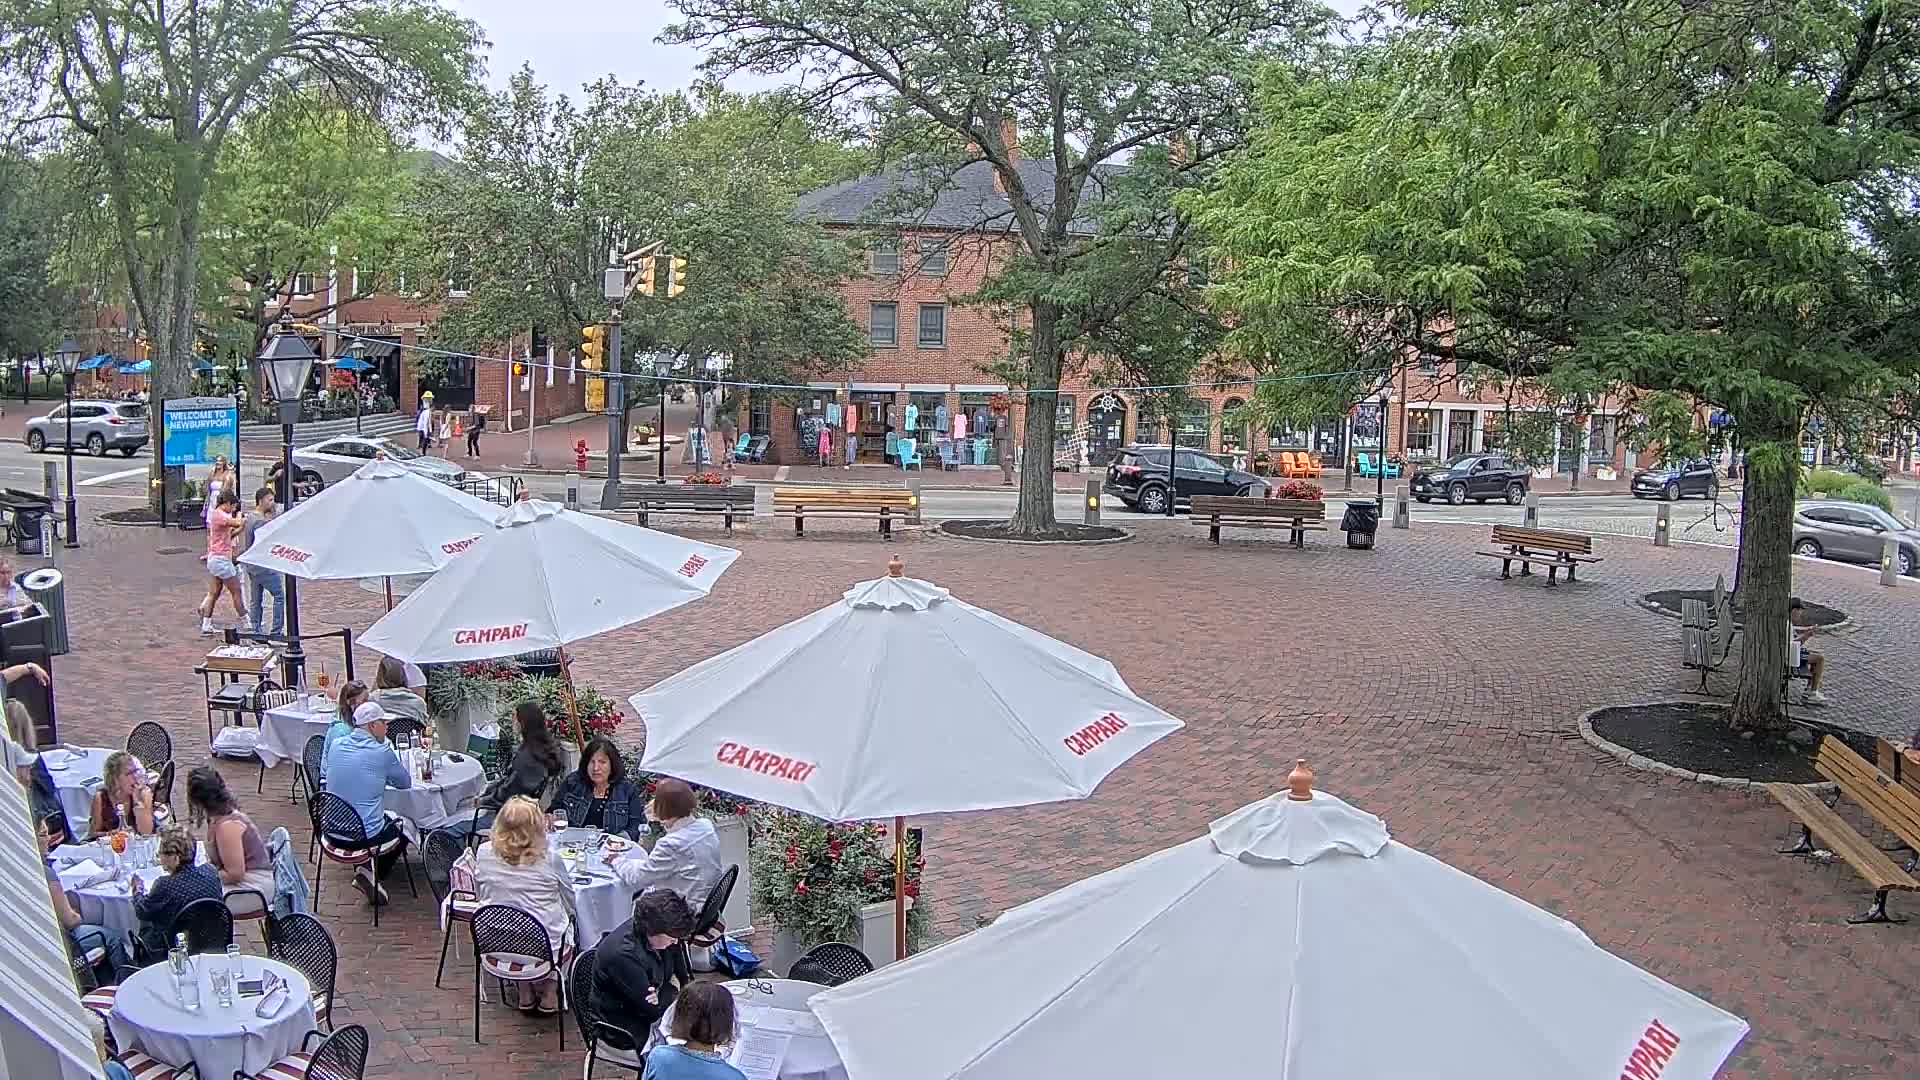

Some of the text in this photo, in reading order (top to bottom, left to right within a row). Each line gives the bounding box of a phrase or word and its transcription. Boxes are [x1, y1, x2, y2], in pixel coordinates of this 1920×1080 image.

[170, 410, 227, 420] WELCOME TO
[170, 418, 232, 429] NEWBURYPORT
[441, 535, 483, 554] CAMP
[455, 623, 528, 644] CAMPARI
[1064, 712, 1128, 755] CAMPARI
[717, 743, 816, 781] CAMPARI
[1620, 1018, 1680, 1080] MPARI
